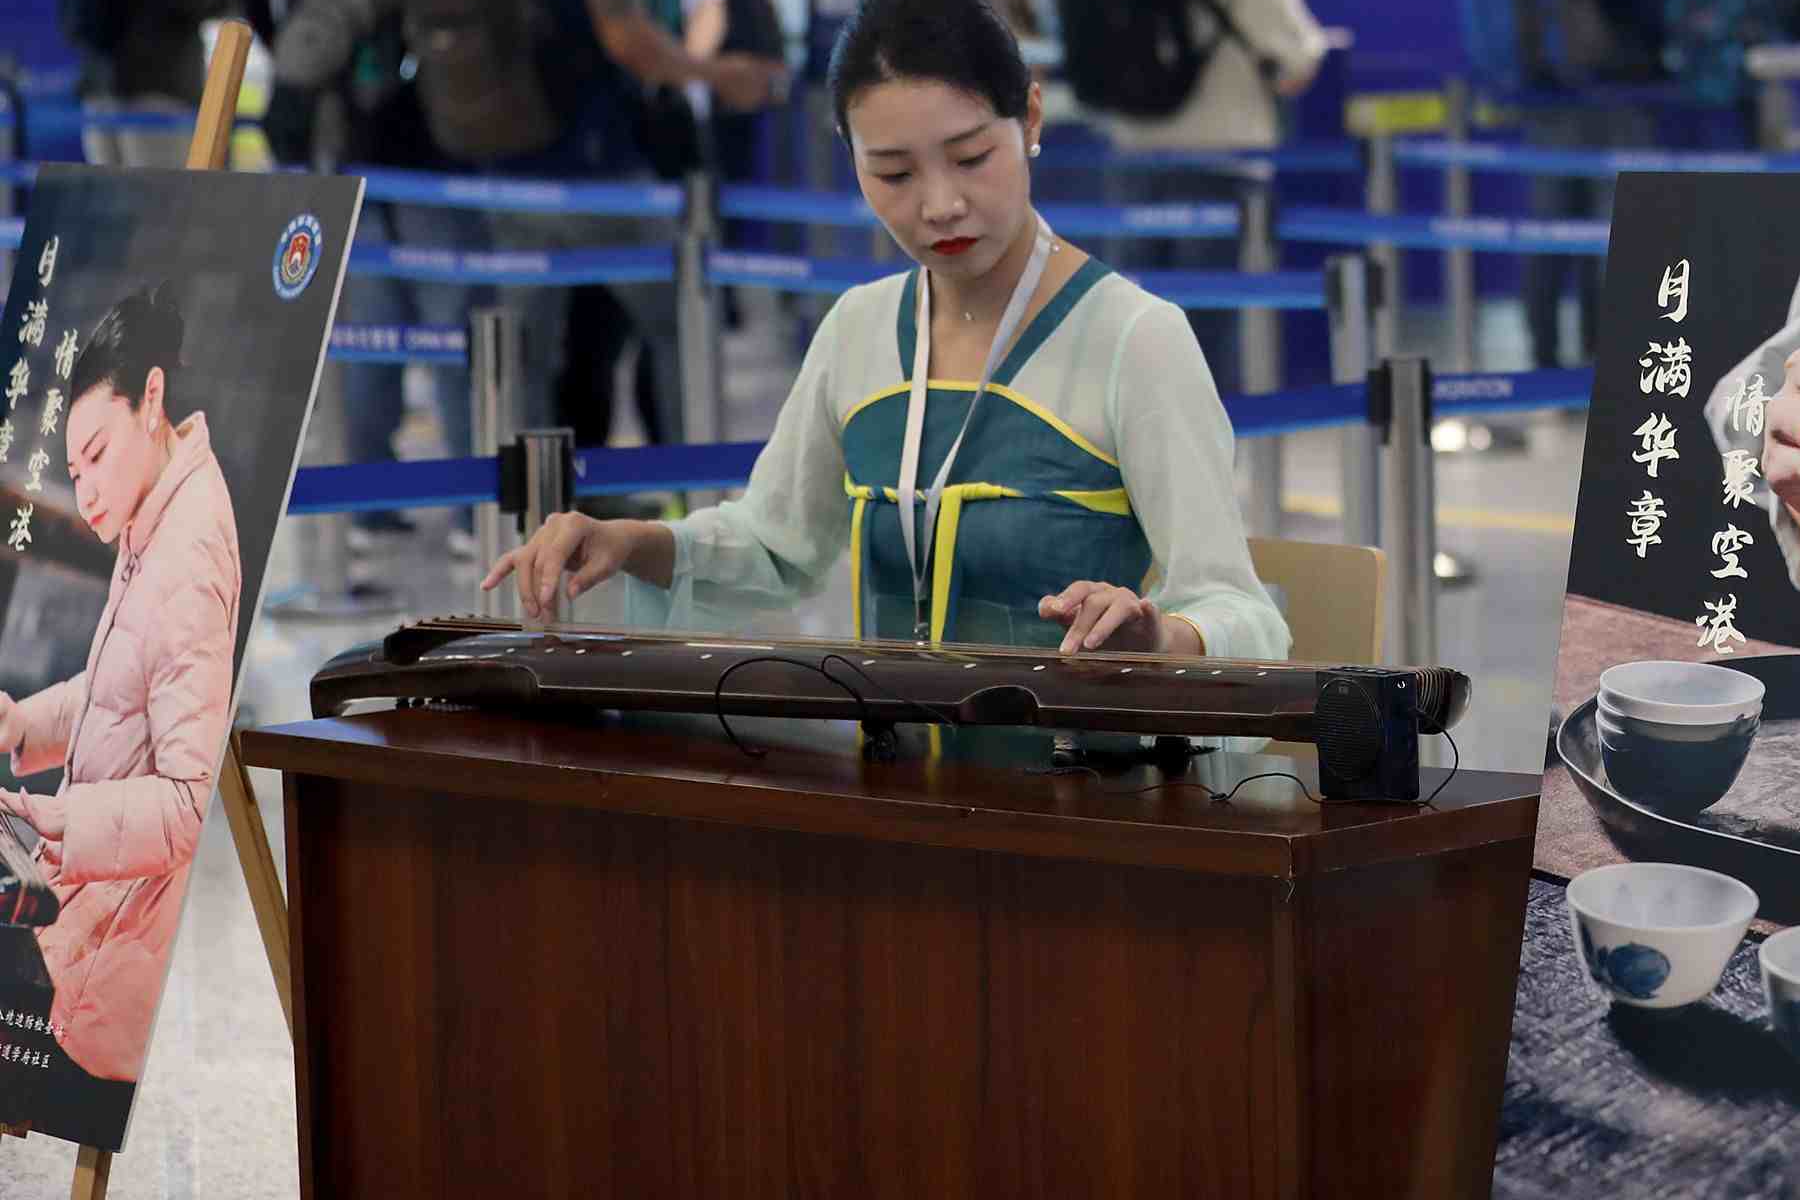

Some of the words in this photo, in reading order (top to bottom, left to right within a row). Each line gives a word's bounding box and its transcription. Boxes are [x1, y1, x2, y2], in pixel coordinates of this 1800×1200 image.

[8, 328, 79, 552] 情聚空港
[1626, 258, 1694, 559] 月满华章
[1695, 374, 1772, 655] 情聚空港
